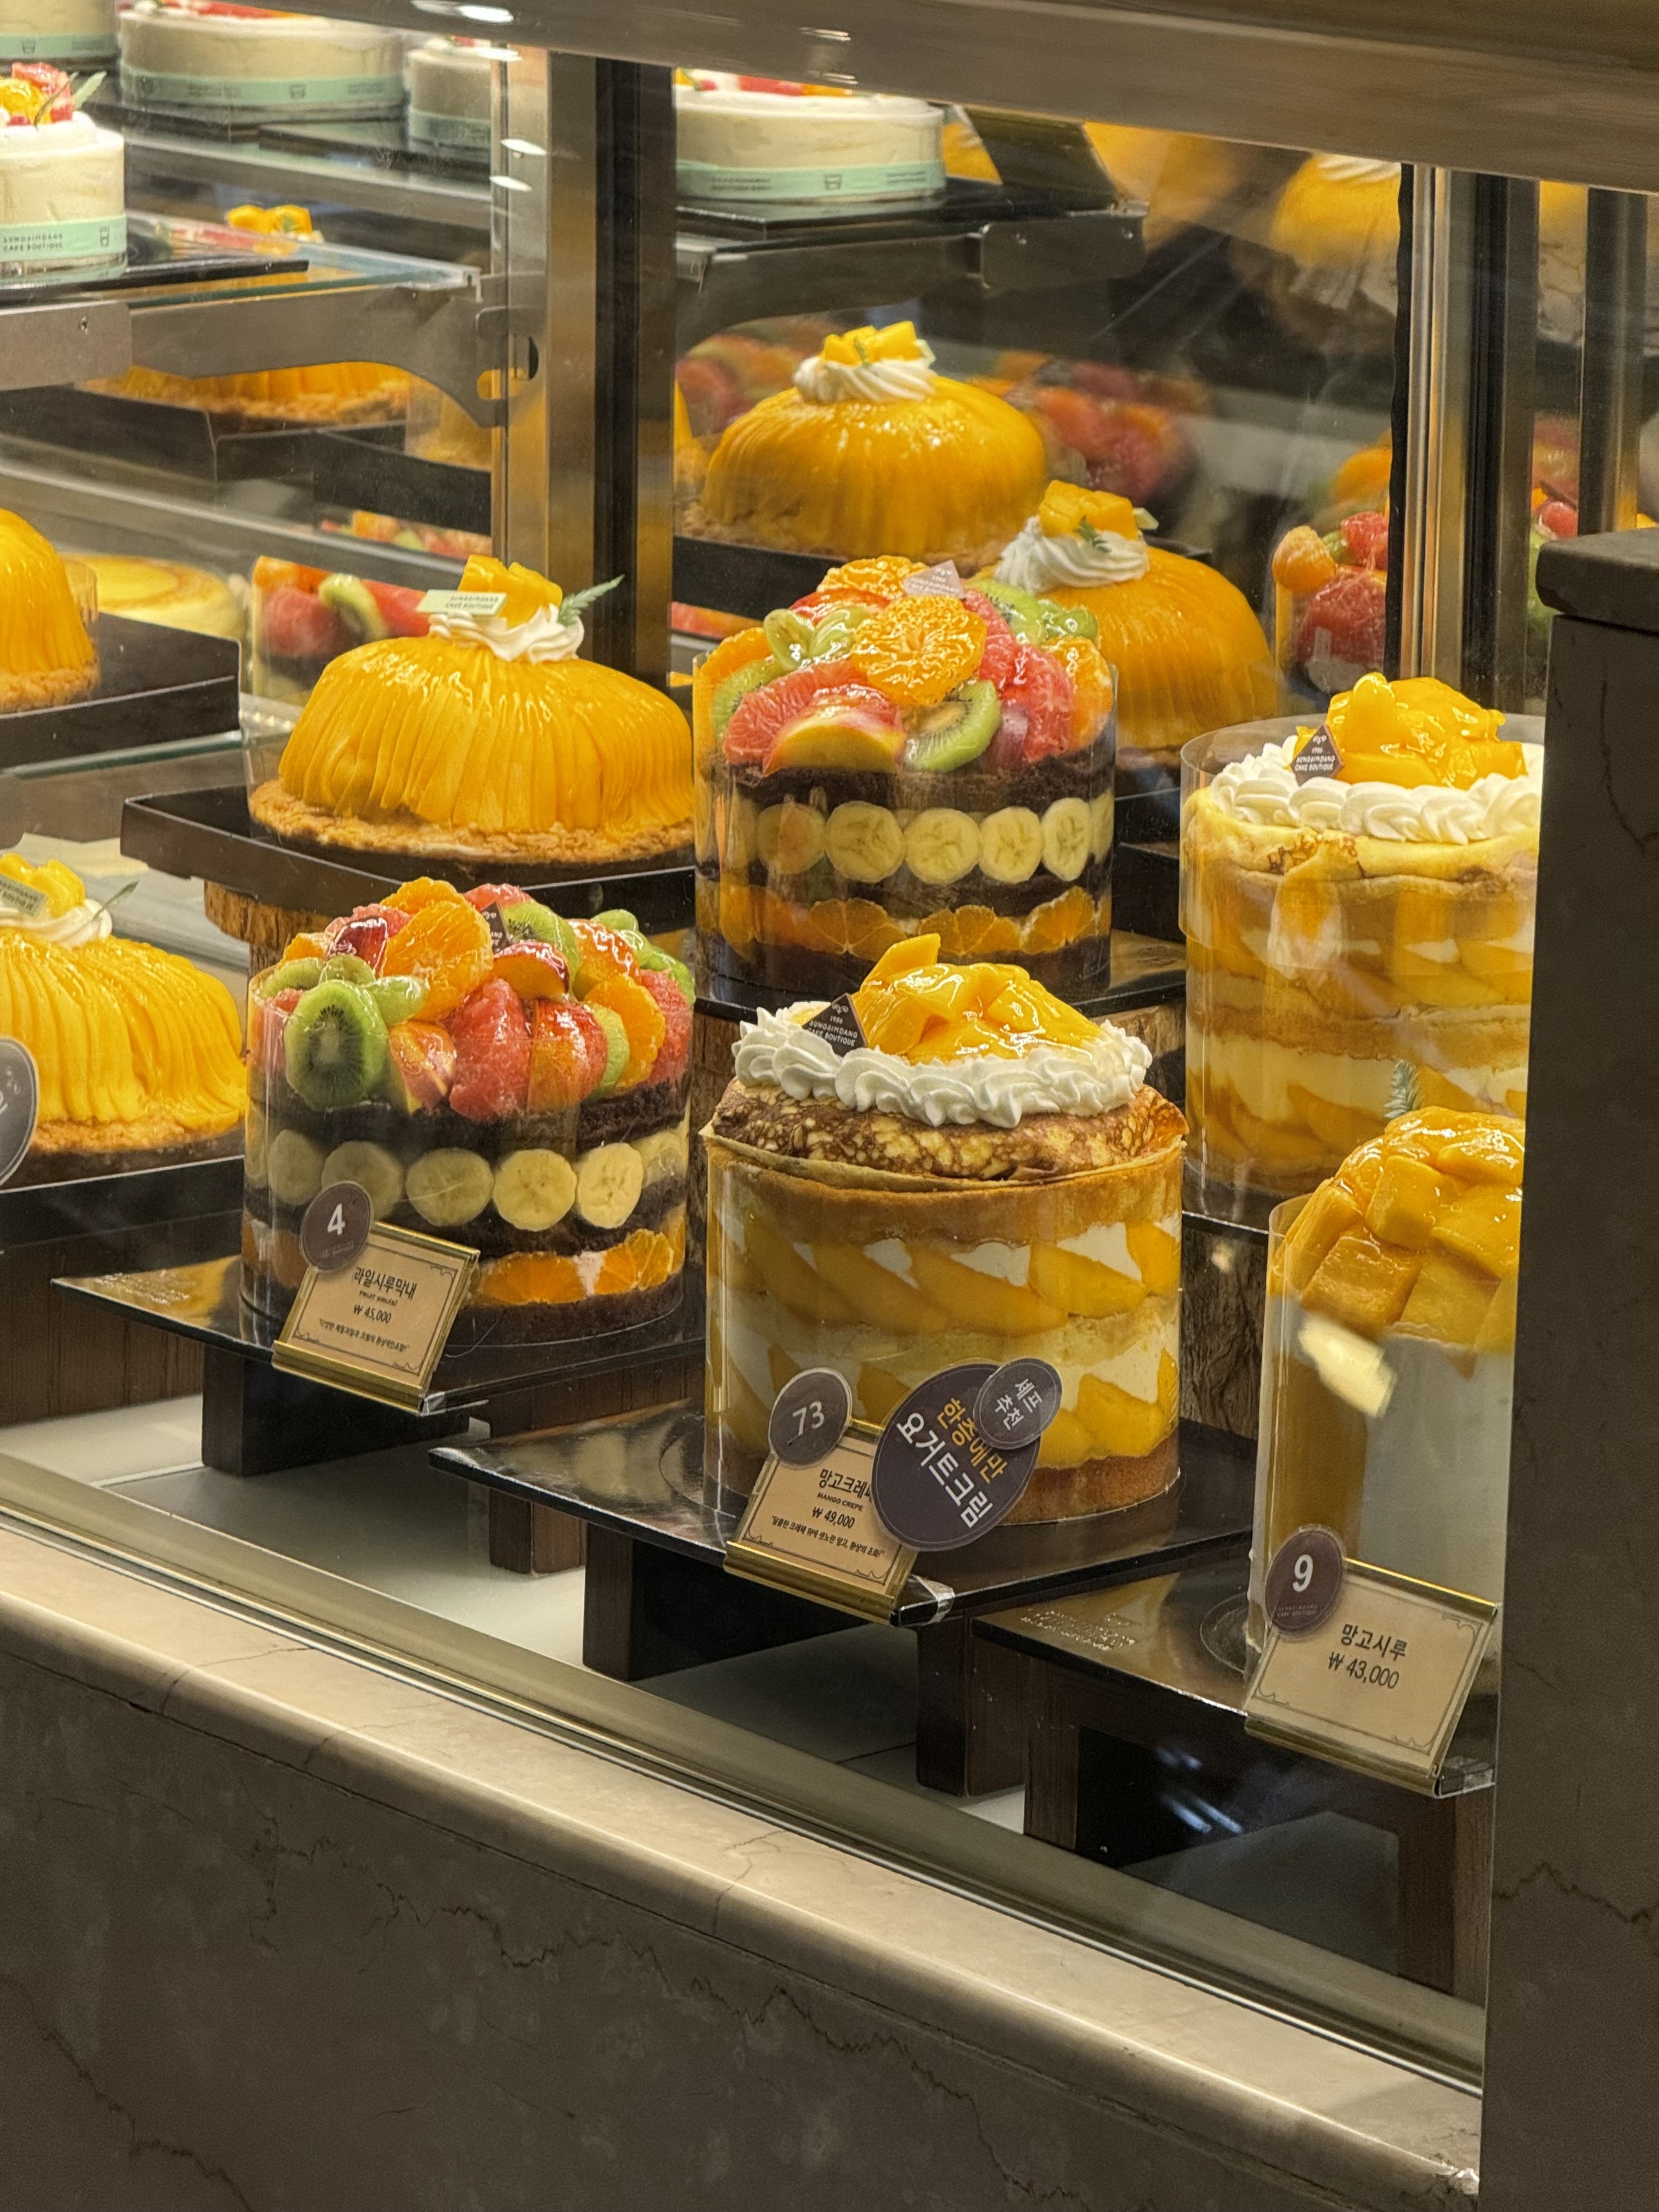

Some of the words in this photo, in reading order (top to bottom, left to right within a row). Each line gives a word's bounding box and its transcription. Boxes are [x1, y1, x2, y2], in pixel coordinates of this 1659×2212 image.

[809, 1020, 858, 1039] SUNGSIMDANG
[825, 1032, 855, 1047] BOUTIQUE
[328, 1203, 346, 1235] 4
[354, 1267, 417, 1300] 과일시루막내
[364, 1307, 392, 1324] 45,000
[792, 1400, 825, 1436] 73
[995, 1394, 1024, 1431] 추천
[896, 1413, 994, 1528] 요거트크림
[817, 1492, 841, 1504] MANGO
[842, 1499, 864, 1511] CREPE
[824, 1510, 855, 1529] 49,000
[1292, 1554, 1313, 1592] 9
[1340, 1623, 1408, 1662] 망고시루
[1346, 1659, 1400, 1690] 43,000
